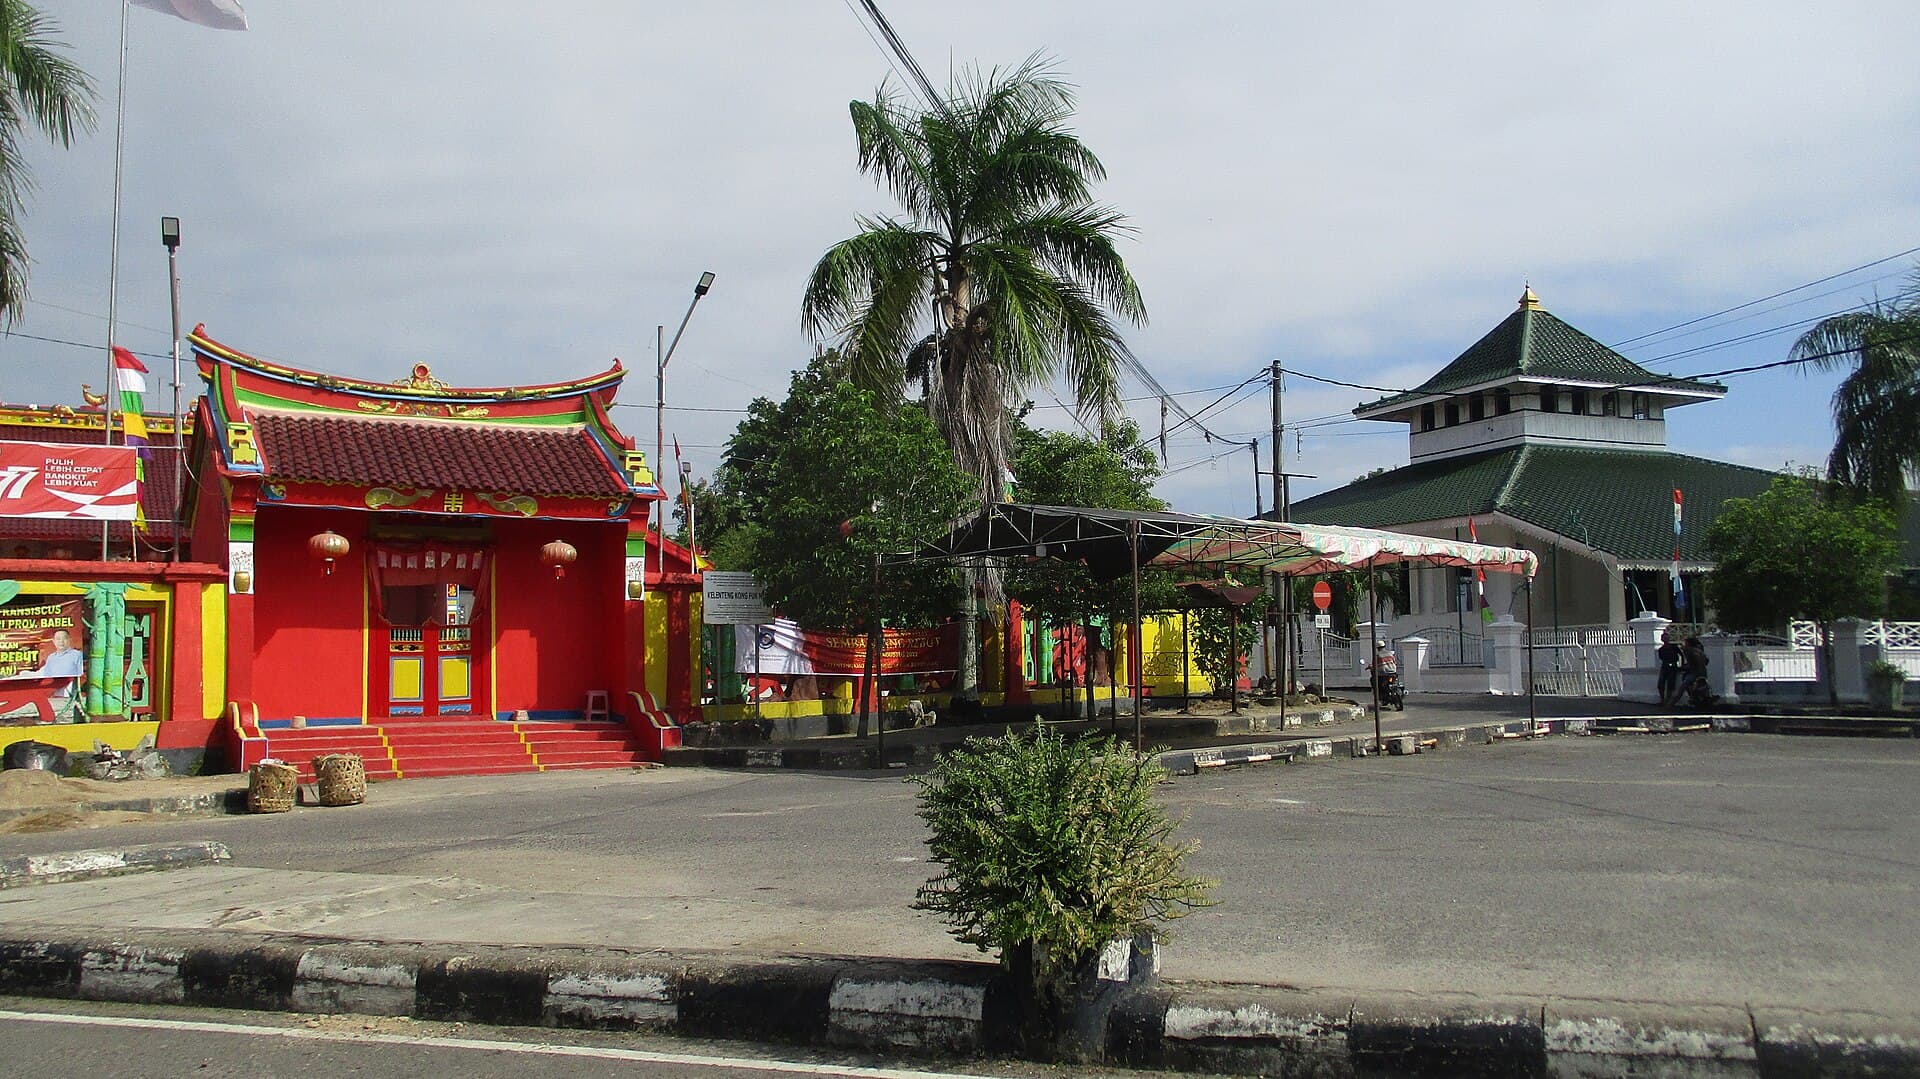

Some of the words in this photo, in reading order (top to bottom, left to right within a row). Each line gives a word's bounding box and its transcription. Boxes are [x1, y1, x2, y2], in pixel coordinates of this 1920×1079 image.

[45, 458, 74, 466] PULIH
[45, 465, 72, 473] LEBIH
[44, 479, 72, 487] LEBIH
[8, 618, 38, 630] PROV.
[41, 617, 74, 628] BABEL
